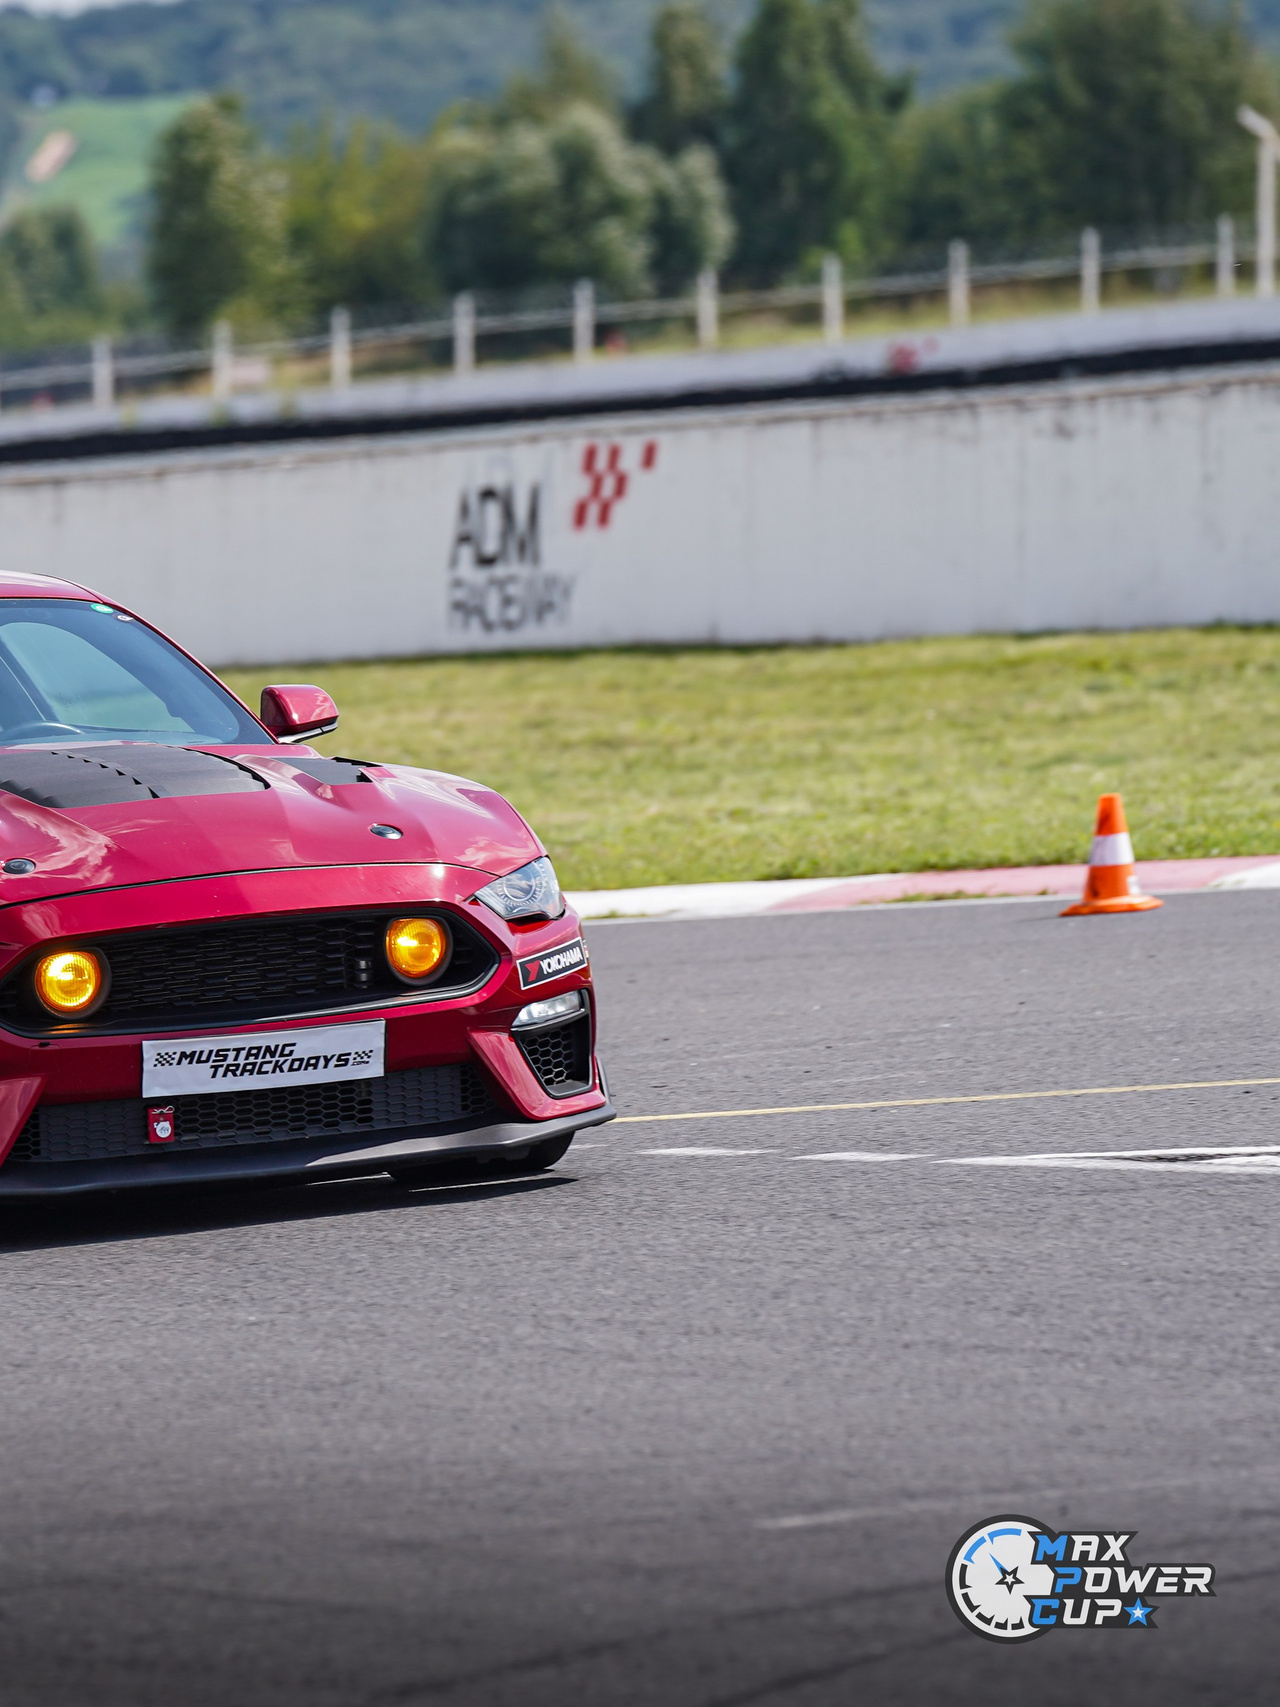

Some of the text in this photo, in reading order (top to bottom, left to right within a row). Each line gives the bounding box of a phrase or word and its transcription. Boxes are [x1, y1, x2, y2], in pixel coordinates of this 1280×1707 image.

[449, 484, 540, 567] ADM
[539, 946, 583, 975] YOKOHAMA
[176, 1042, 297, 1066] MUSTANG
[210, 1052, 352, 1079] TRACKDAYS
